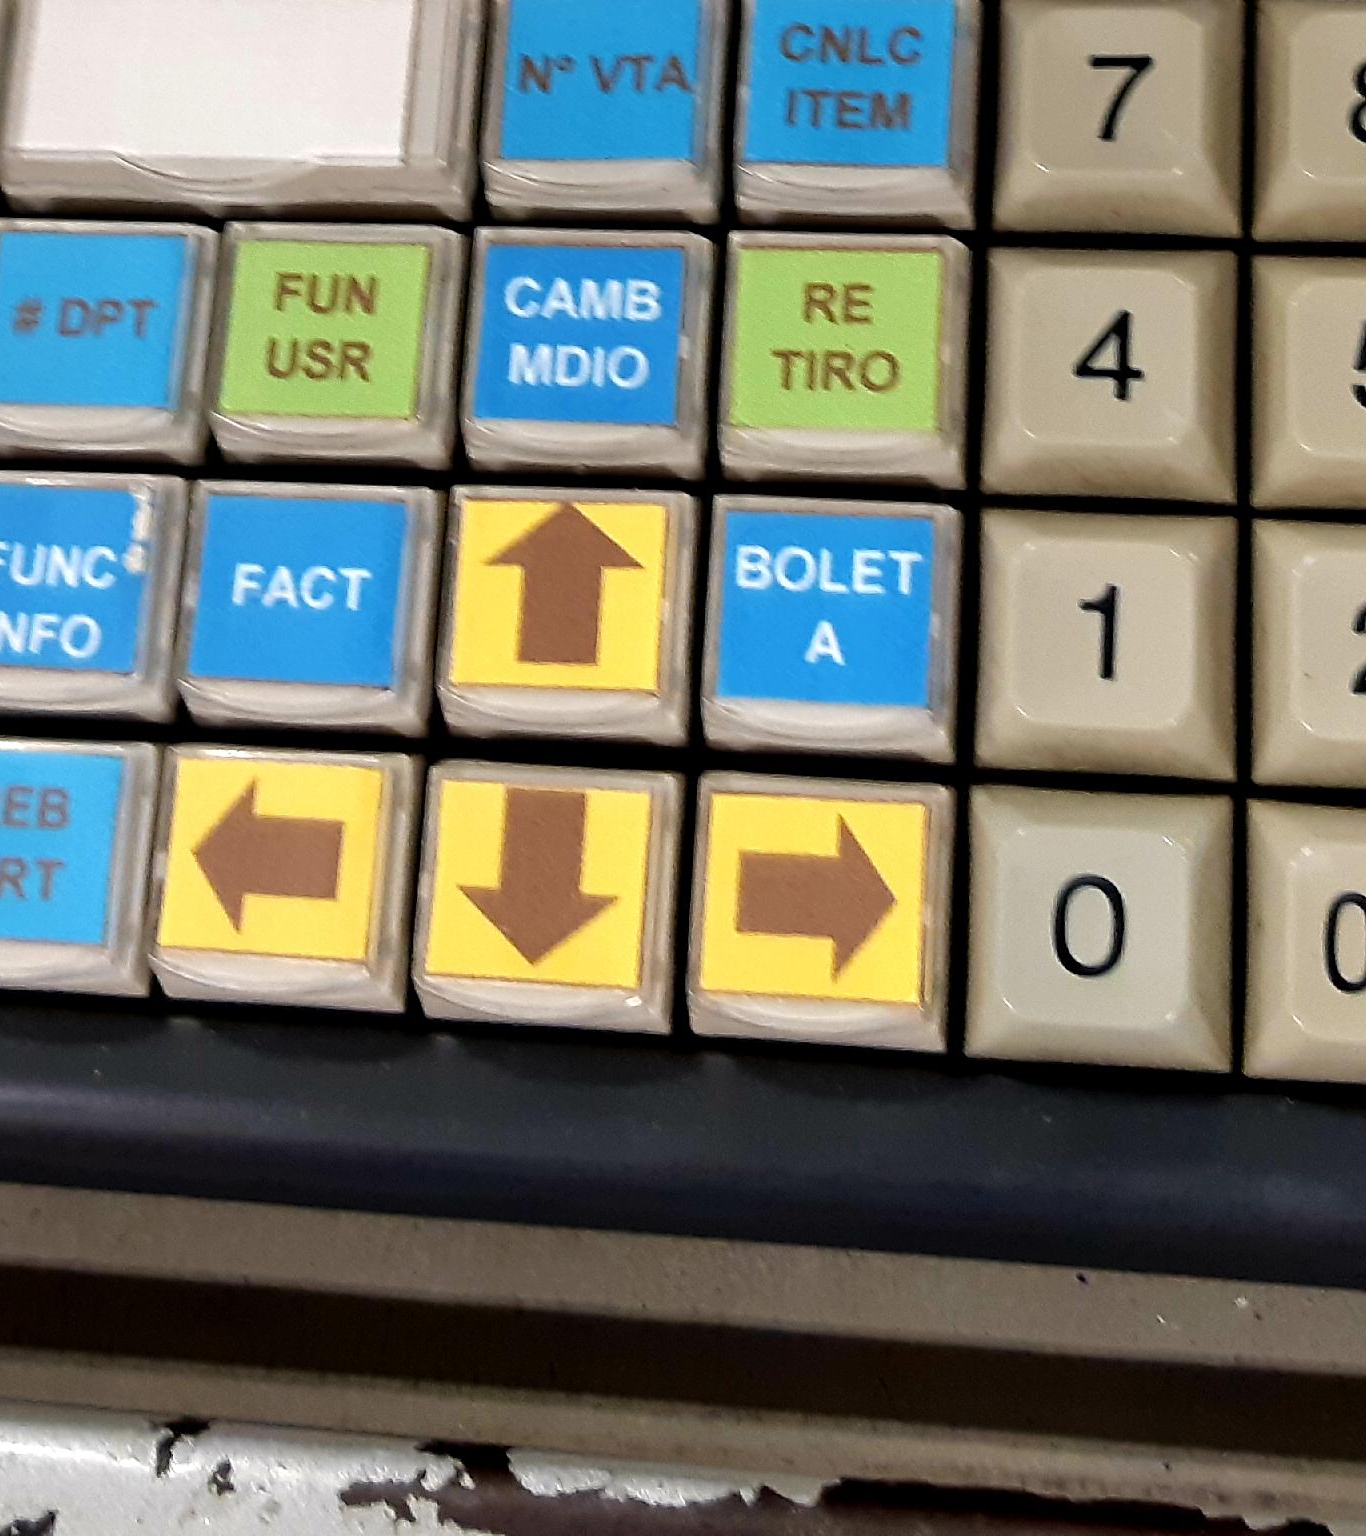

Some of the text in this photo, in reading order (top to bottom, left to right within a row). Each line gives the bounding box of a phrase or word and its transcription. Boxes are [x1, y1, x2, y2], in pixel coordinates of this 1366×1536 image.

[780, 23, 922, 66] CNLC
[591, 55, 697, 94] VTA
[785, 89, 912, 130] ITEM
[1089, 55, 1153, 142] 7
[275, 273, 378, 315] FUN
[505, 277, 661, 321] CAMB
[803, 283, 873, 324] RE
[56, 298, 157, 338] DPT
[266, 339, 372, 382] USR
[508, 344, 648, 389] MDIO
[772, 349, 900, 393] TIRO
[1074, 311, 1144, 401] 4
[232, 563, 371, 610] FACT
[736, 546, 922, 595] BOLET
[806, 621, 844, 665] A
[1080, 585, 1118, 680] 1
